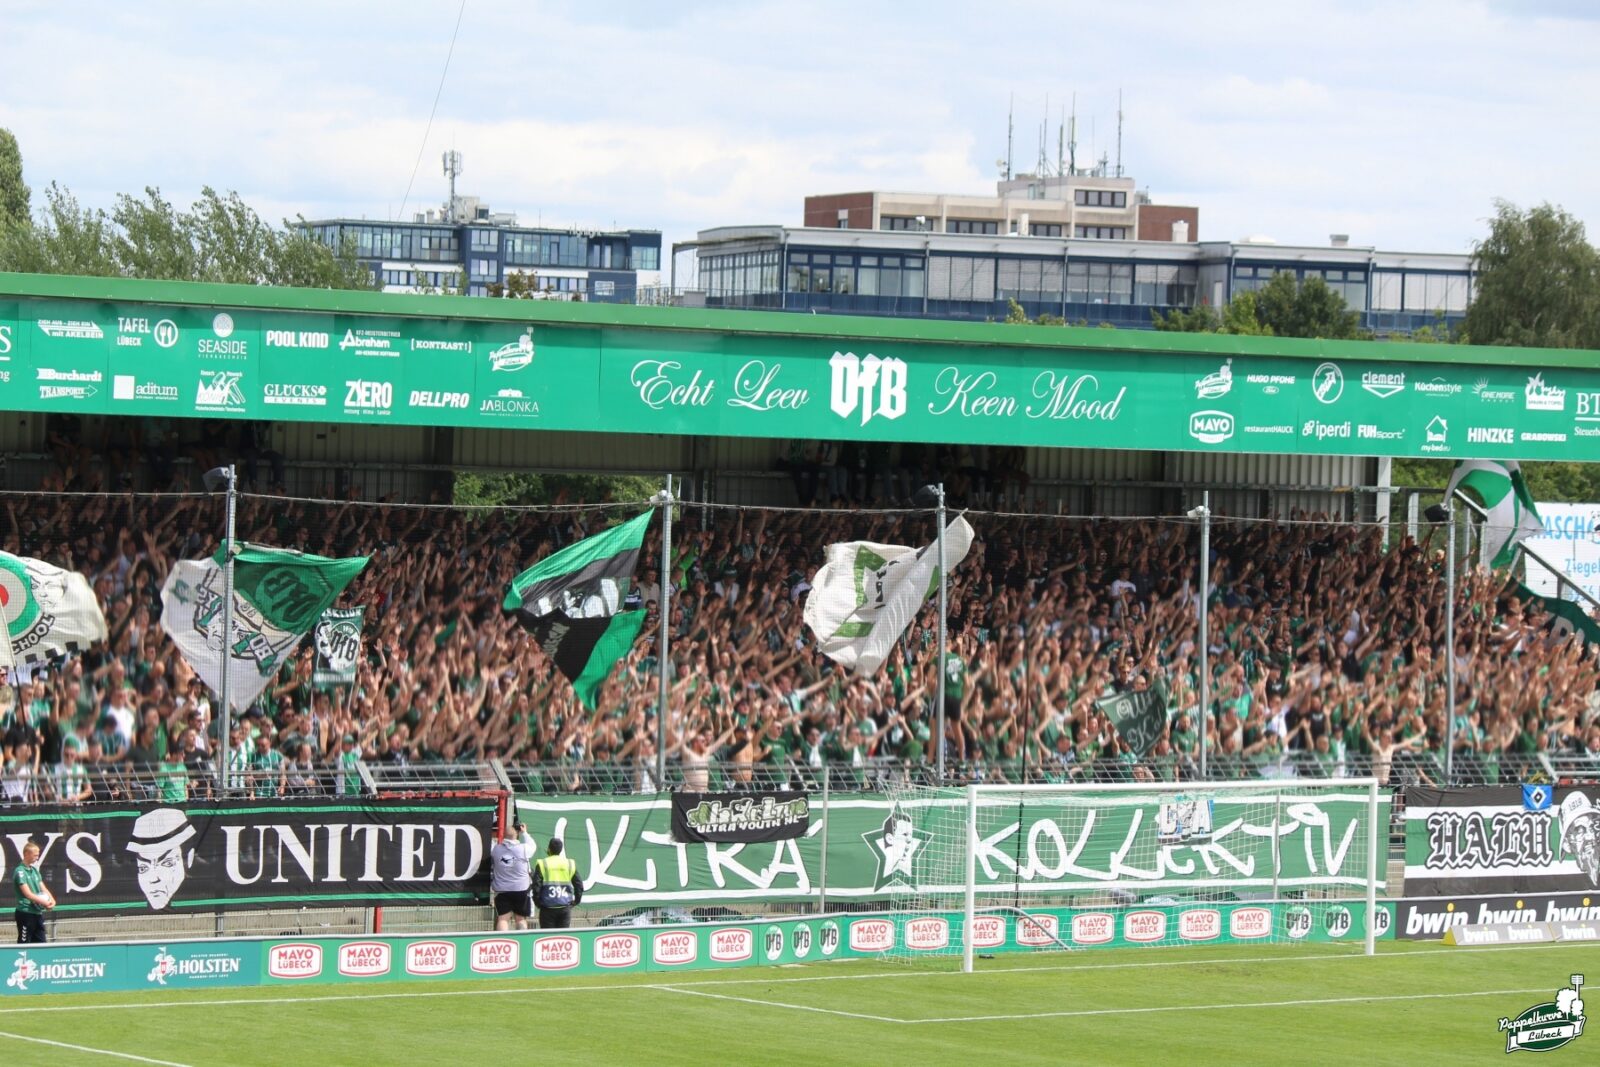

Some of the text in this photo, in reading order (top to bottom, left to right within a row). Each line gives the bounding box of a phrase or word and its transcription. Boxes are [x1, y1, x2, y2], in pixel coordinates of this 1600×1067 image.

[118, 317, 151, 333] TAFEL
[117, 335, 142, 347] LÜBECK
[339, 329, 391, 350] Abraham
[198, 339, 247, 354] SEASIDE
[44, 368, 102, 382] Burchardt
[1362, 371, 1405, 385] clement
[136, 382, 178, 396] aditum
[264, 384, 319, 397] GLÜCKS
[631, 360, 810, 410] Echt Leev
[829, 351, 908, 427] VfB
[409, 391, 470, 408] DELLPRO
[928, 367, 1127, 420] Keen Mood
[480, 399, 539, 412] JABLONKA
[1194, 417, 1230, 432] MAYO
[1316, 420, 1351, 440] iperdi
[1467, 428, 1514, 443] HINZKE
[1521, 432, 1566, 442] GRABOWSKI
[697, 821, 736, 833] ULTRA
[739, 817, 781, 831] YOUTH
[220, 824, 483, 884] UNITED
[1079, 917, 1107, 928] MAYO
[1131, 915, 1159, 925] MAYO
[1186, 914, 1213, 924] MAYO
[1237, 912, 1264, 922] MAYO
[1325, 912, 1349, 930] VfB
[1405, 903, 1469, 935] bwin
[1477, 900, 1537, 925] bwin
[857, 924, 887, 934] MAYO
[912, 923, 941, 932] MAYO
[1462, 924, 1543, 943] bwin bwin
[1561, 923, 1598, 939] bwin
[602, 939, 632, 949] MAYO
[661, 936, 689, 946] MAYO
[717, 933, 745, 944] MAYO
[766, 934, 782, 952] VfB
[793, 931, 810, 949] VfB
[820, 928, 837, 947] VfB
[857, 934, 886, 943] LÜBECK
[347, 947, 382, 958] MAYO
[414, 946, 448, 957] MAYO
[479, 944, 512, 955] MAYO
[541, 941, 572, 952] MAYO
[661, 946, 689, 956] LÜBECK
[717, 944, 744, 953] LÜBECK
[278, 949, 313, 959] MAYO
[479, 955, 511, 964] LÜBECK
[541, 952, 572, 961] LÜBECK
[602, 949, 632, 959] LÜBECK
[179, 958, 241, 974] HOLSTEN
[278, 960, 312, 969] LÜBECK
[347, 958, 381, 967] LÜBECK
[414, 957, 447, 966] LÜBECK
[40, 963, 105, 979] HOLSTEN
